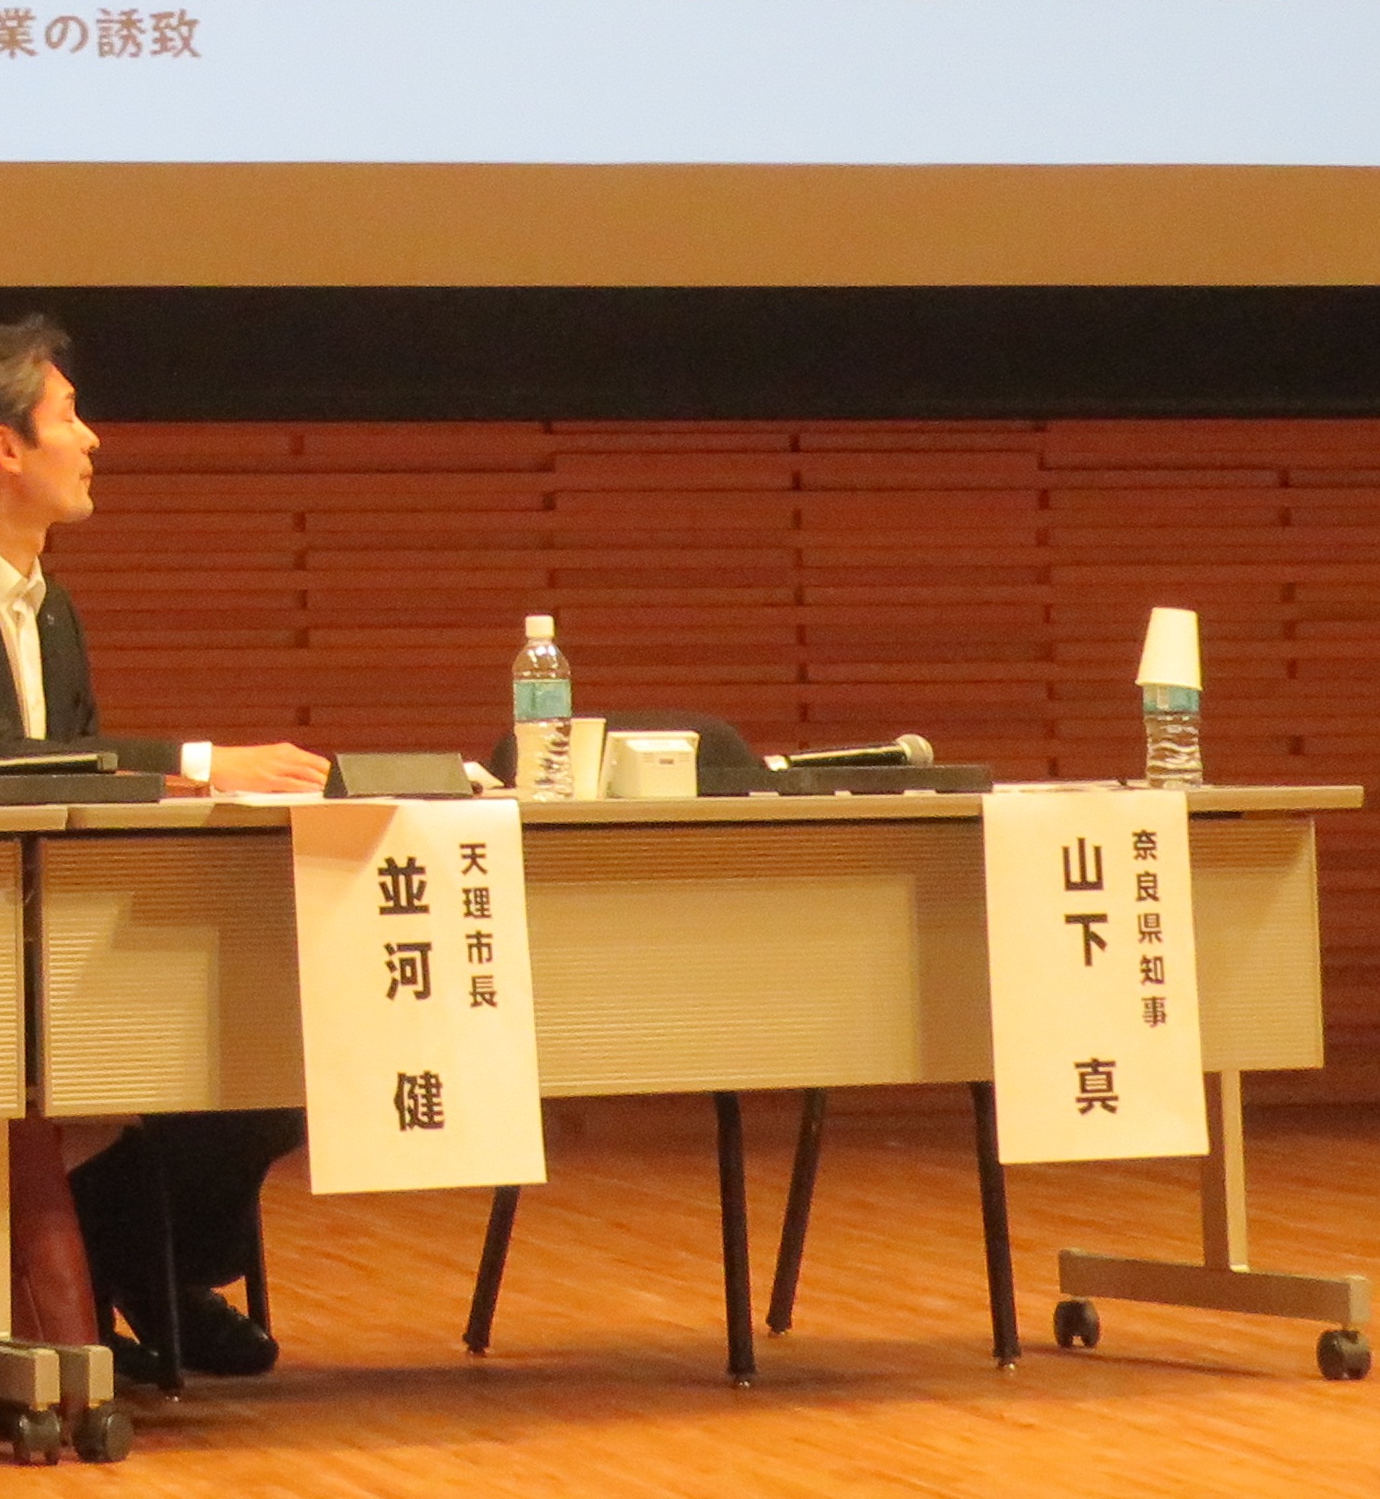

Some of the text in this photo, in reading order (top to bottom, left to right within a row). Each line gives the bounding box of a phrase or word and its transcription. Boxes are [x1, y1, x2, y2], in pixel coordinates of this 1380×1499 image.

[377, 856, 445, 1132] 並河 健
[459, 842, 498, 1008] 天理市長
[1062, 837, 1119, 1115] 山下 真
[1132, 830, 1168, 1028] 奈良県知事
